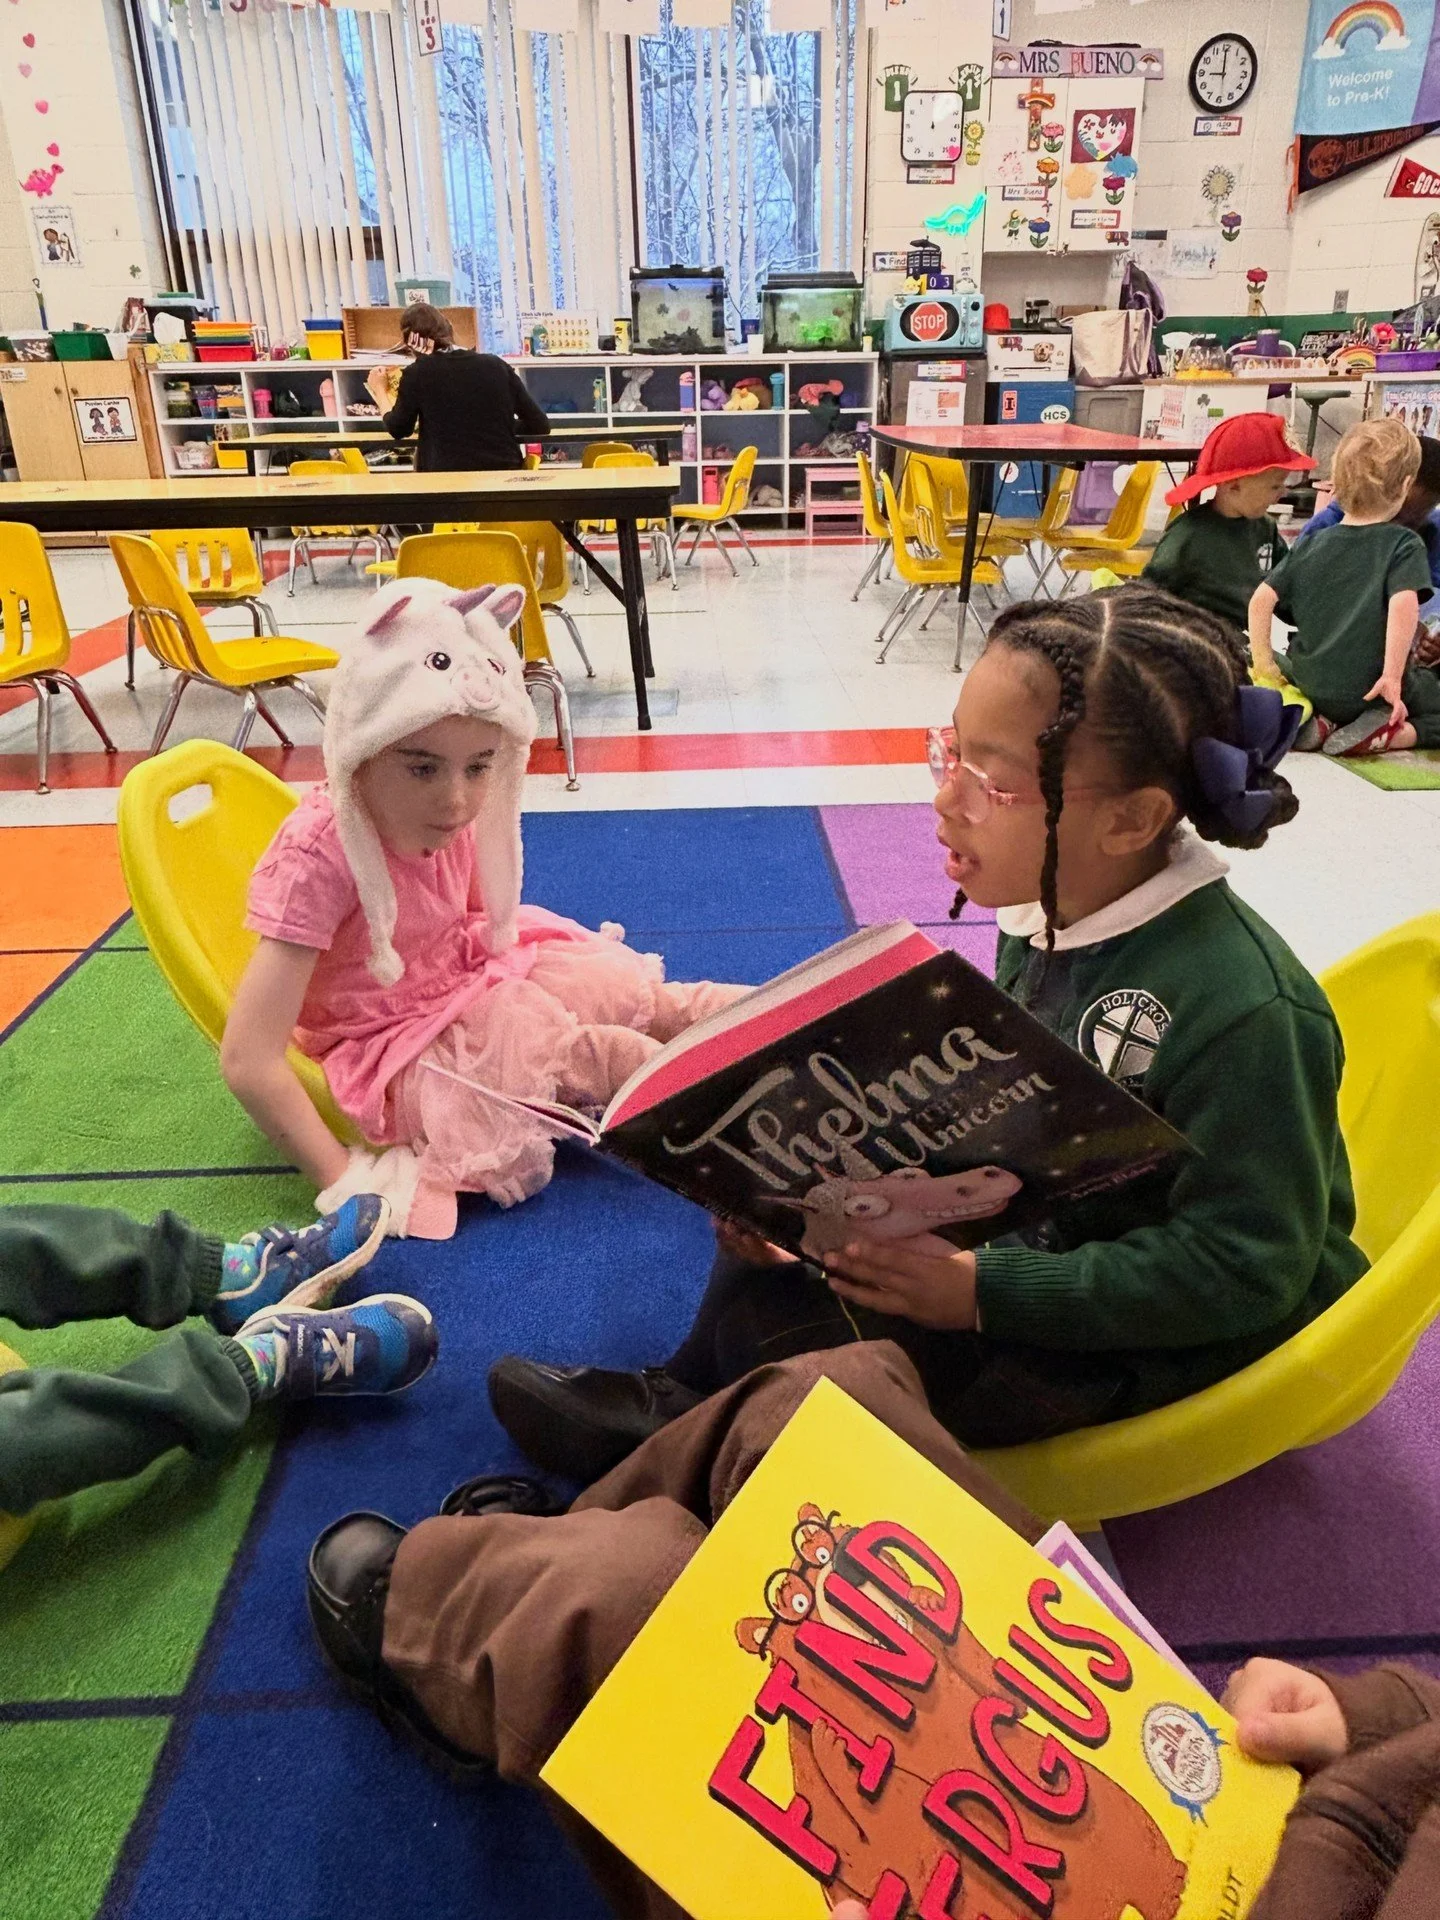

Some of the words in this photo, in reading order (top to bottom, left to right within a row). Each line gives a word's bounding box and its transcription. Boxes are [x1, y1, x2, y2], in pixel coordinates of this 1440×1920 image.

[1019, 51, 1060, 74] MRS
[1071, 51, 1136, 75] BUENO
[1328, 69, 1394, 89] Welcome
[1327, 94, 1341, 107] to
[1345, 86, 1391, 105] Pre-K!
[913, 314, 944, 330] STOP
[1044, 411, 1067, 420] HCS
[661, 1025, 1018, 1192] Thelma
[874, 1069, 1057, 1168] Unicorn
[708, 1520, 964, 1880] FIND
[866, 1577, 1134, 1920] RGUS
